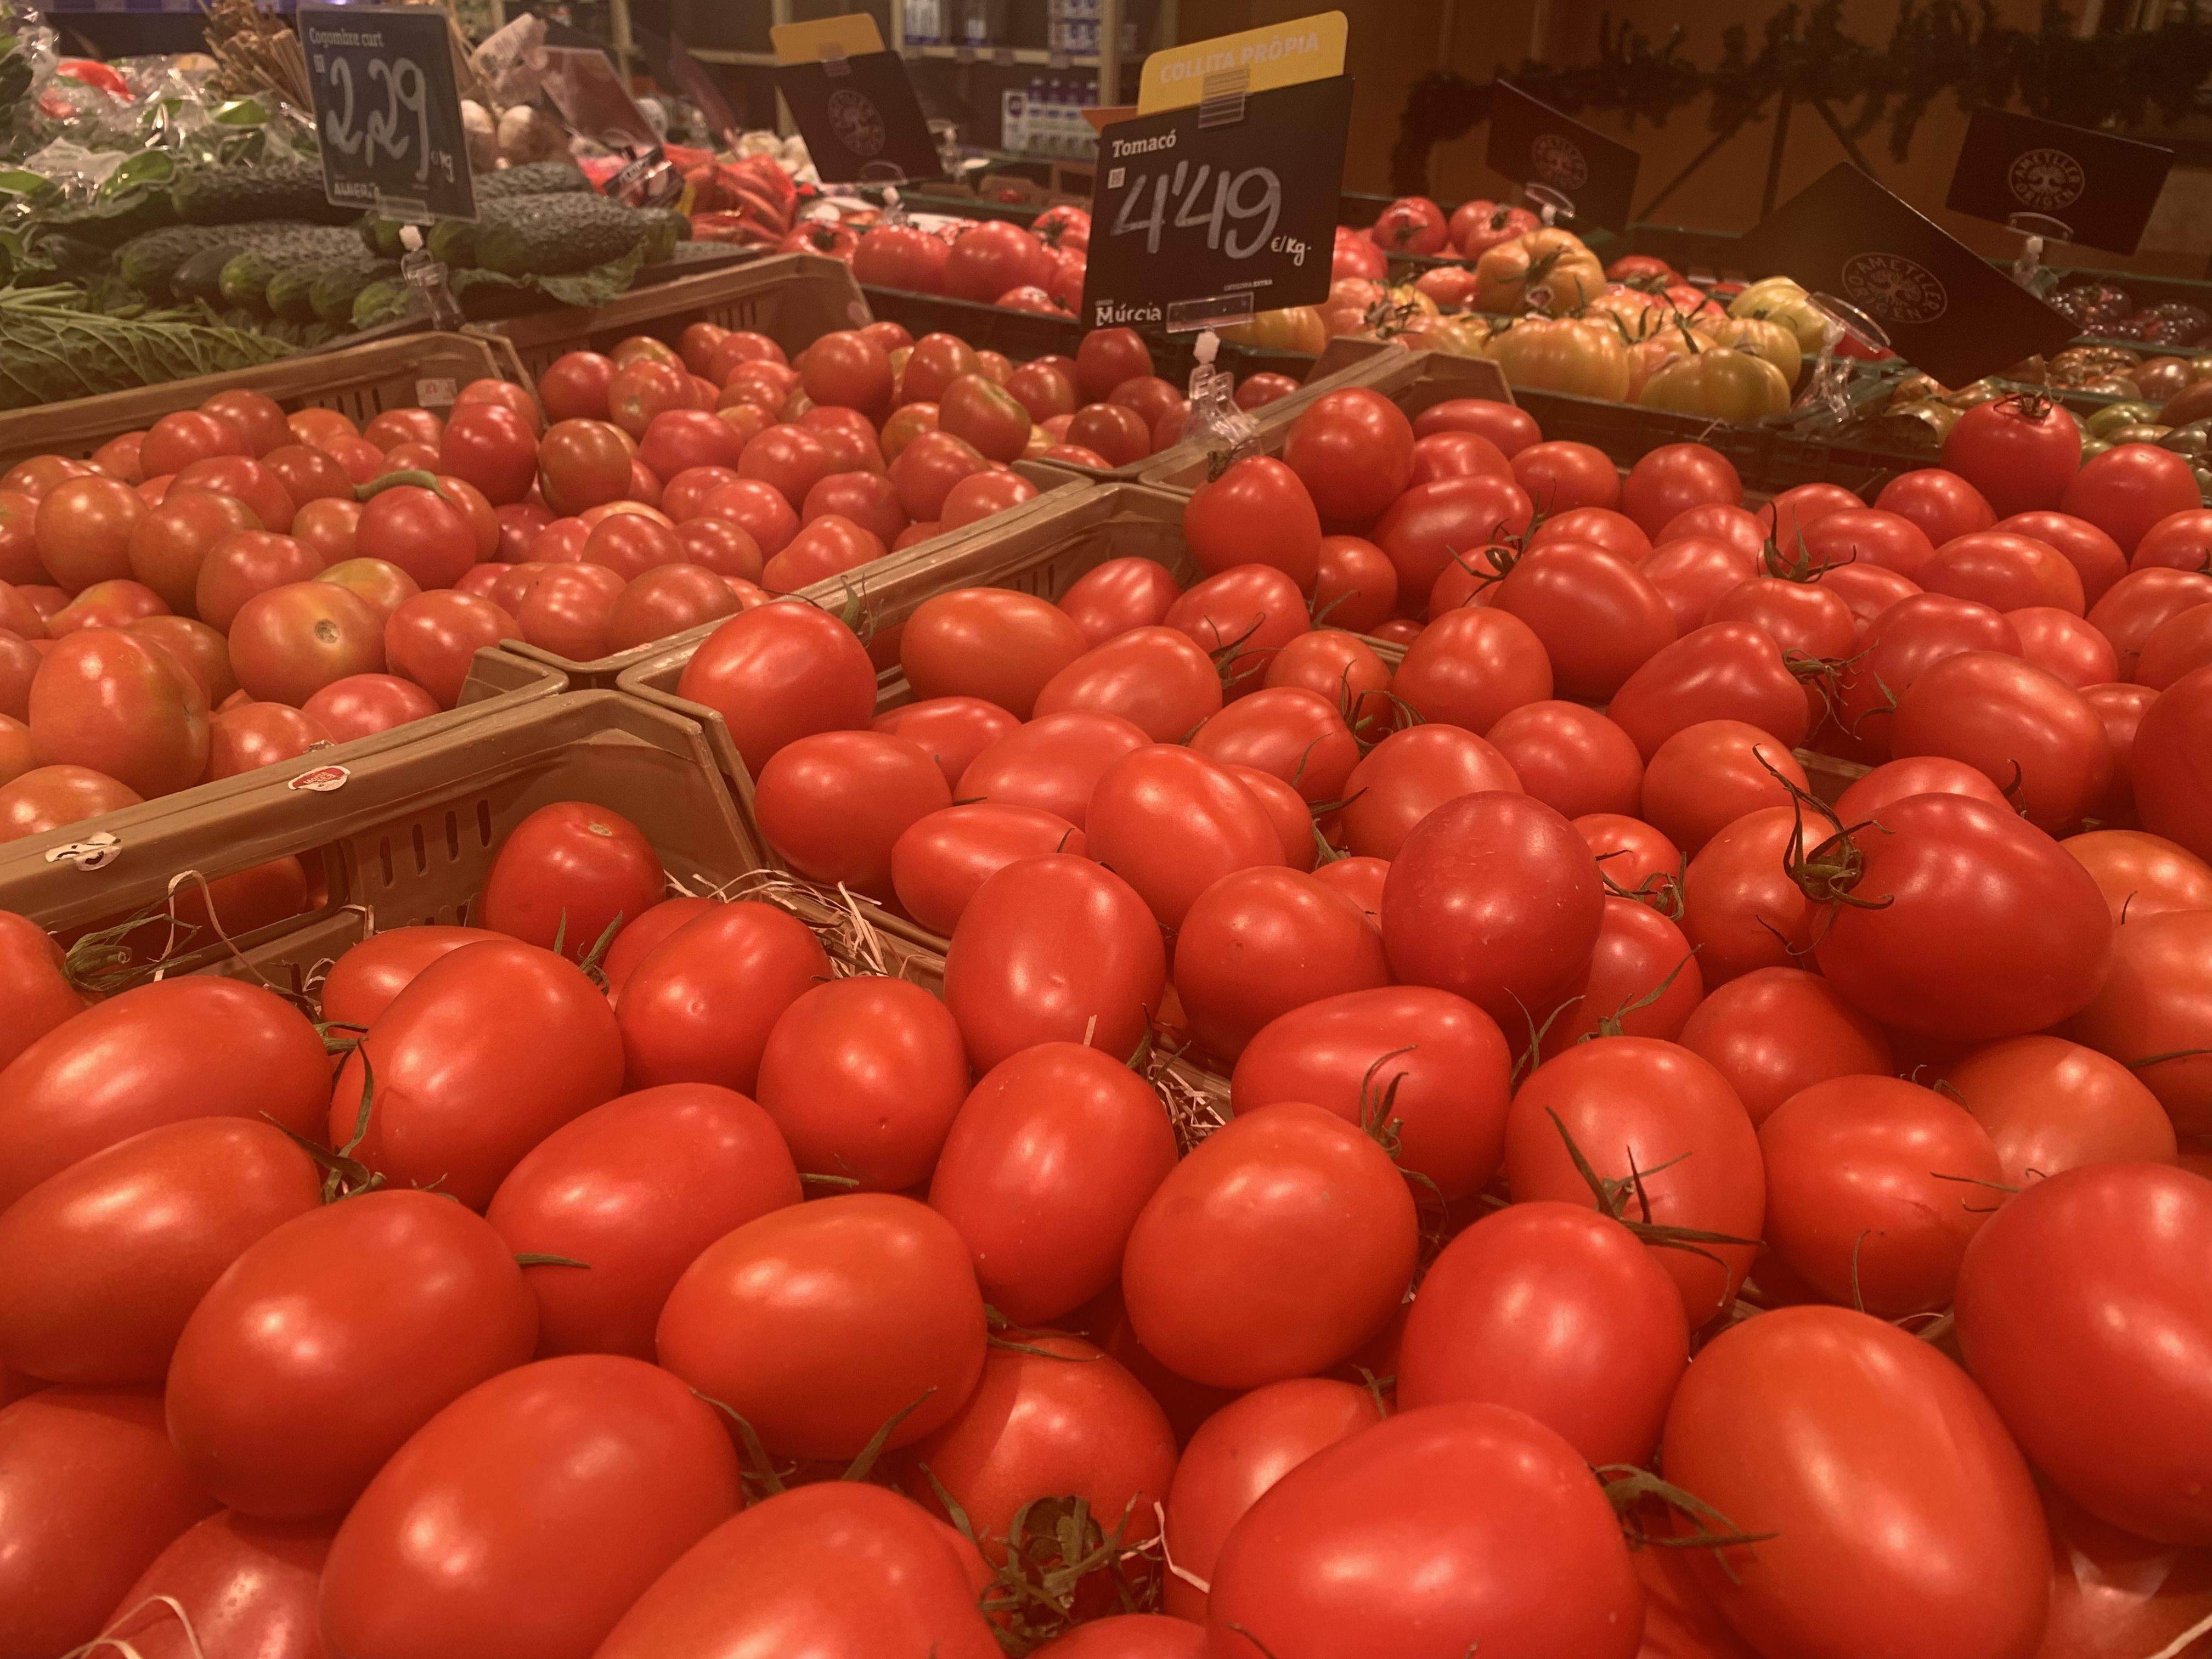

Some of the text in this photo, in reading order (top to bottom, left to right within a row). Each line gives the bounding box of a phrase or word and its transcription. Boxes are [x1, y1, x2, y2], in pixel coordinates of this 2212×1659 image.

[361, 31, 384, 47] curt
[1160, 51, 1235, 84] COLLITA
[1112, 129, 1177, 158] Tomacó
[1856, 257, 1942, 311] AMETLLER
[1096, 302, 1162, 326] Múrcia
